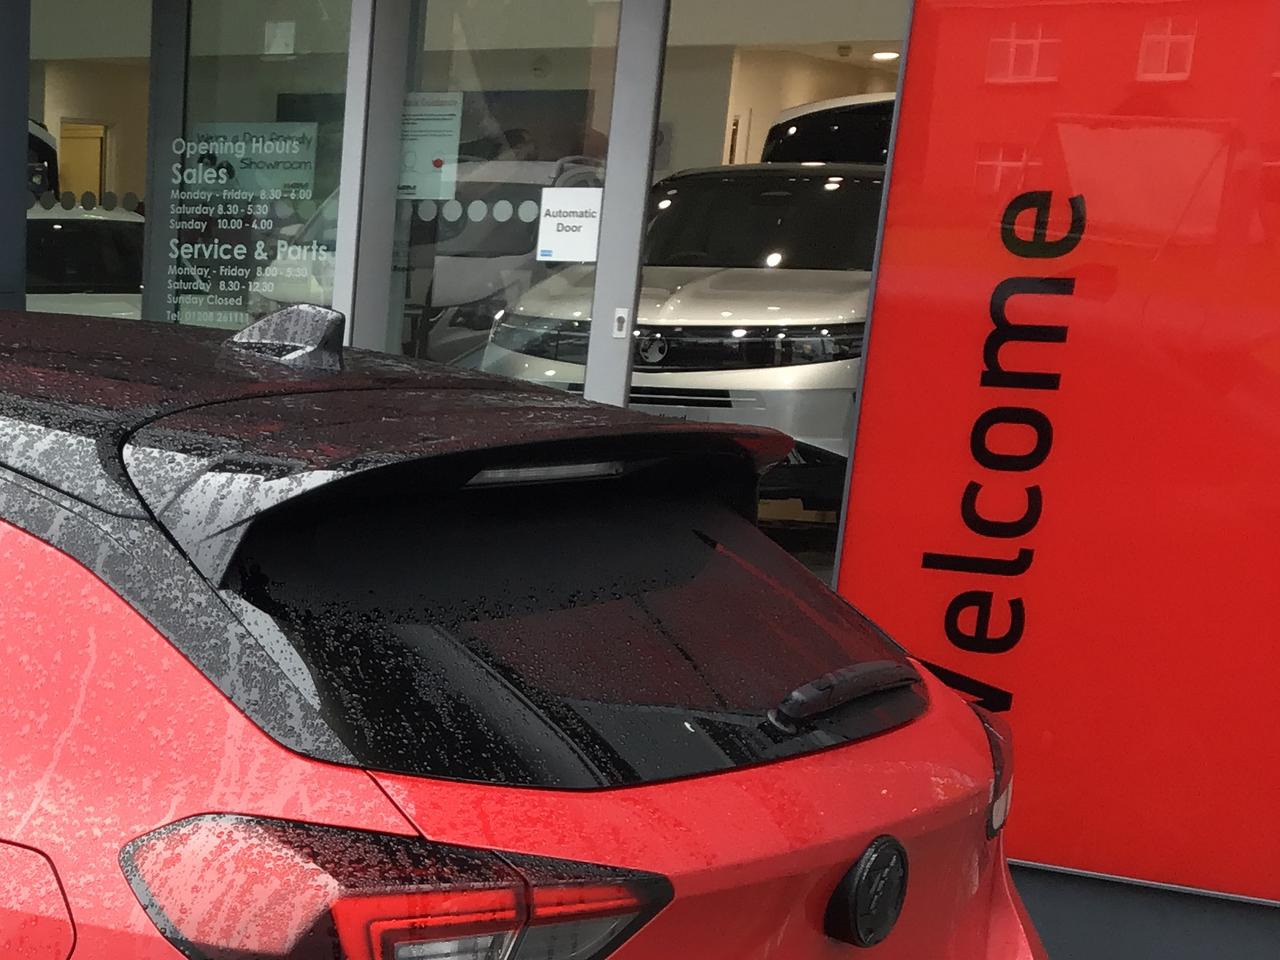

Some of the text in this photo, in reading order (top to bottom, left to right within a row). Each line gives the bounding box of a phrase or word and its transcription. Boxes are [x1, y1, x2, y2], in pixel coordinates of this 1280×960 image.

[172, 137, 300, 158] Opening Hours
[240, 158, 312, 170] Showroom
[172, 163, 228, 184] Sales
[170, 189, 213, 202] Monday
[222, 189, 255, 202] Friday
[169, 204, 215, 217] Saturday
[217, 204, 239, 215] 8.30
[246, 204, 269, 215] 5.30
[543, 208, 598, 219] Automatic
[169, 219, 208, 232] Sunday
[217, 219, 243, 229] 10.00
[251, 219, 273, 230] 4.00
[556, 222, 583, 232] Door
[168, 238, 328, 261] Service & Parts
[167, 265, 211, 278] Monday
[220, 266, 251, 278] Friday
[167, 280, 212, 292] Saturday
[219, 281, 240, 291] 8.30
[166, 293, 242, 306] Sunday Closed
